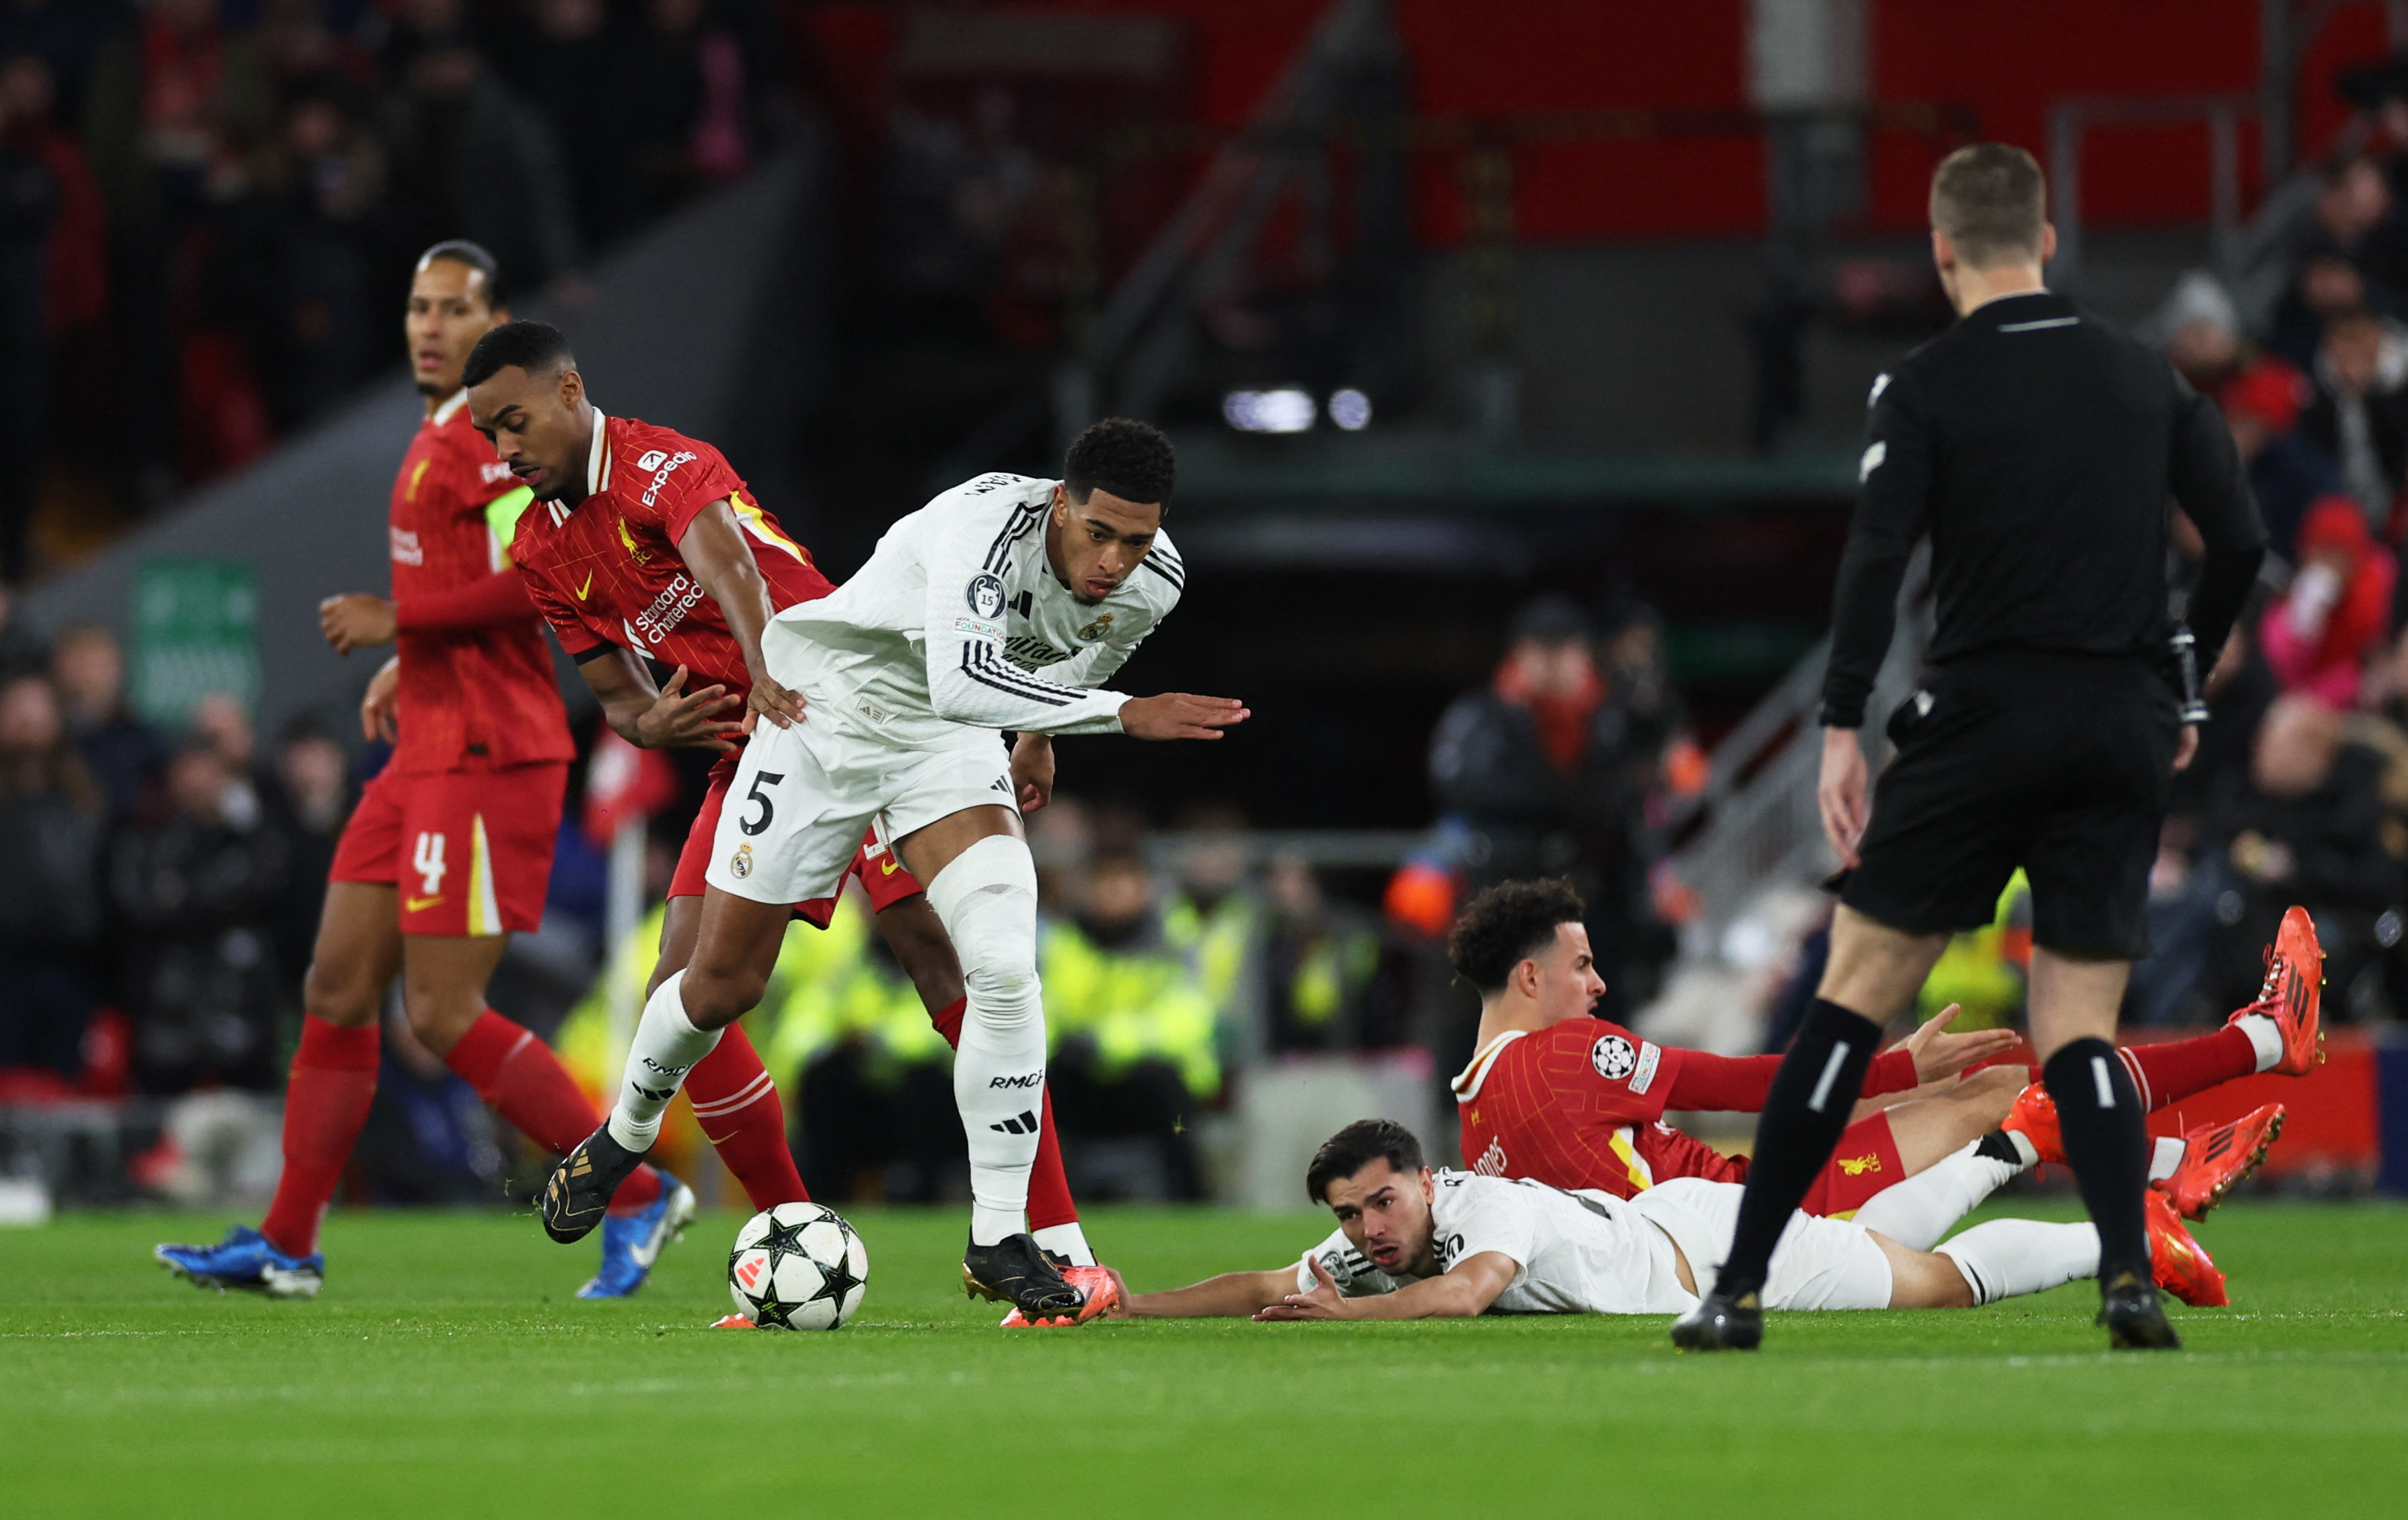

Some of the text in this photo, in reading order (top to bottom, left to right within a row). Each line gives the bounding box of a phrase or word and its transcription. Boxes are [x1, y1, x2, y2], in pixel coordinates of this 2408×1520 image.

[982, 594, 993, 606] 15
[739, 770, 785, 836] 5
[414, 832, 446, 895] 4
